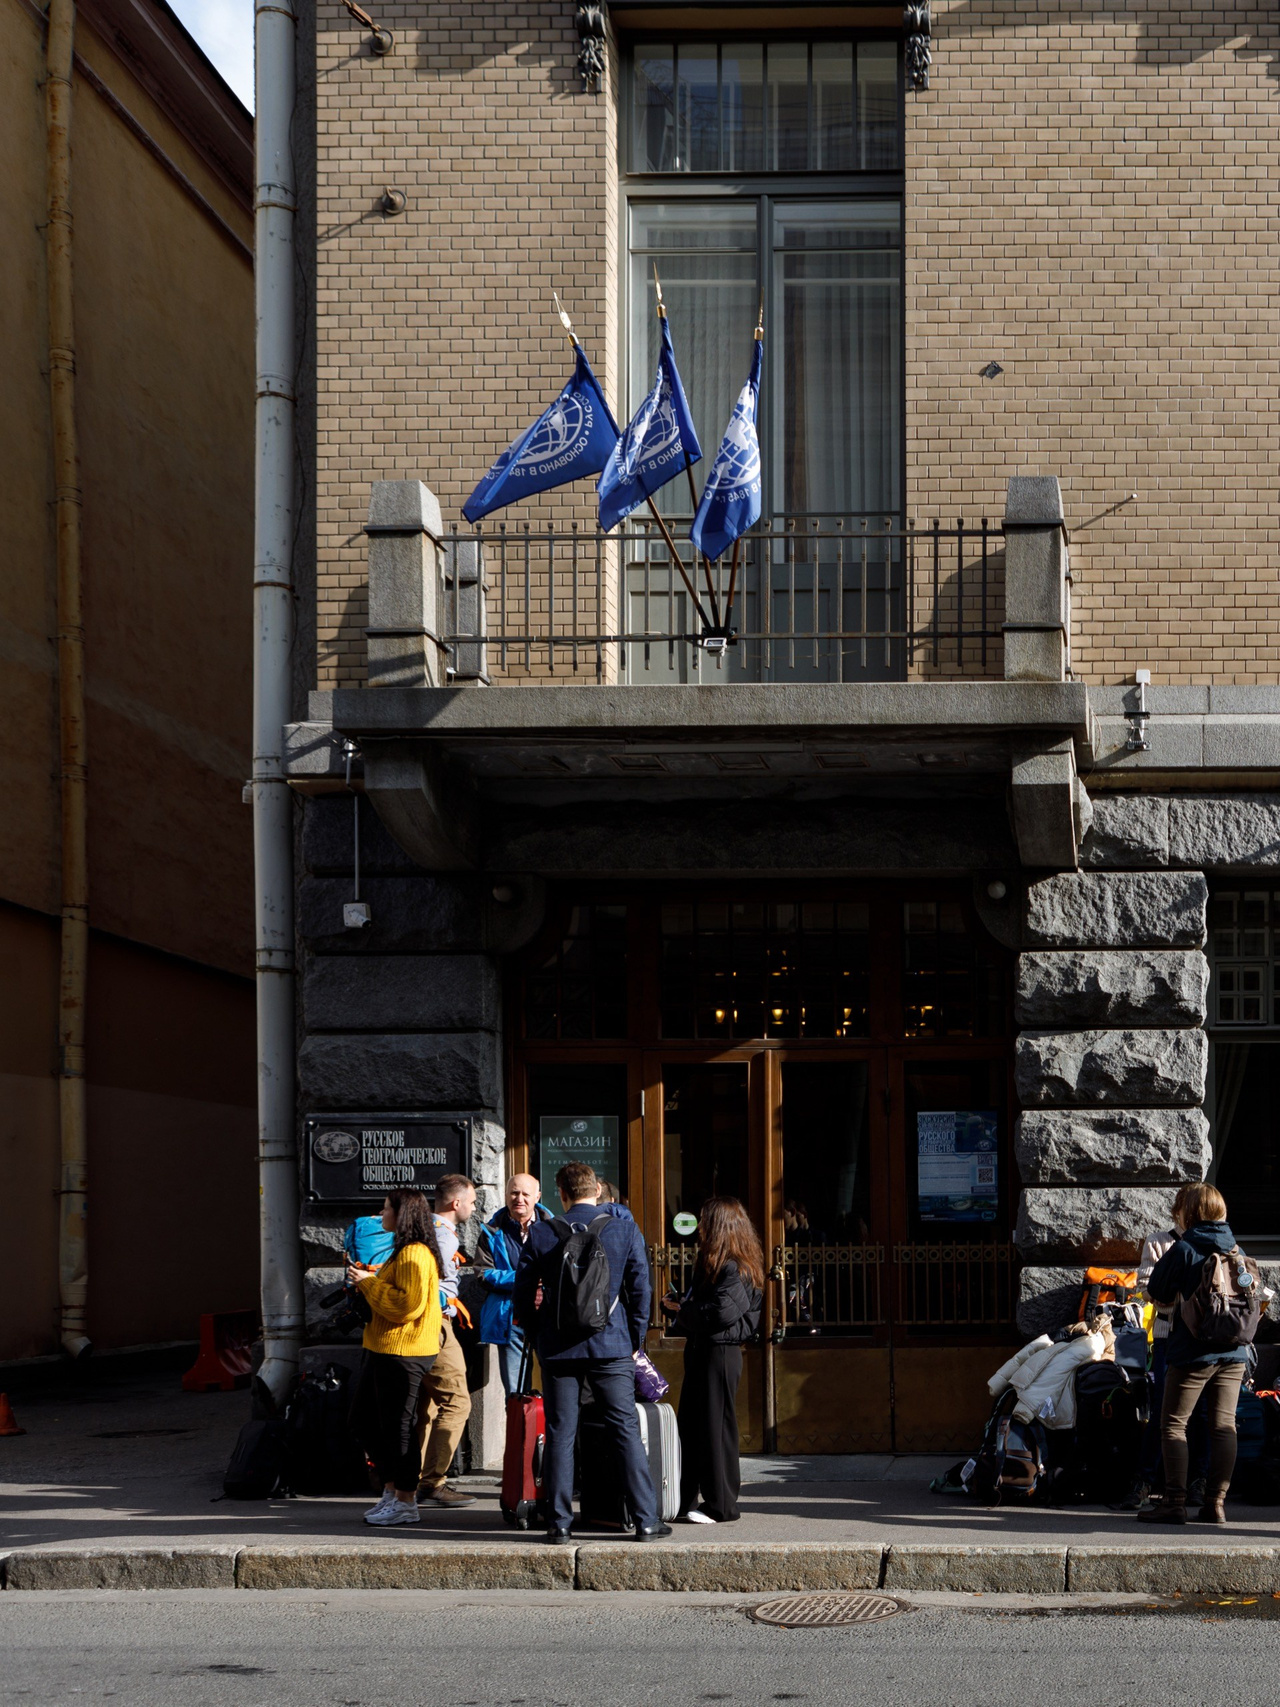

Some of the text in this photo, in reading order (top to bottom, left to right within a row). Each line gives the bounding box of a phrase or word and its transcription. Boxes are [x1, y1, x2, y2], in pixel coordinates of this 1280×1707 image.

[362, 1131, 405, 1147] РУССКОЕ
[548, 1136, 611, 1147] МАГАЗИН
[919, 1131, 955, 1140] РУССКОГО
[919, 1144, 955, 1153] ОБЩЕСТВА
[362, 1148, 447, 1164] ГЕОГРАФИЧЕСКОЕ
[363, 1165, 415, 1183] ОБЩЕСТВО
